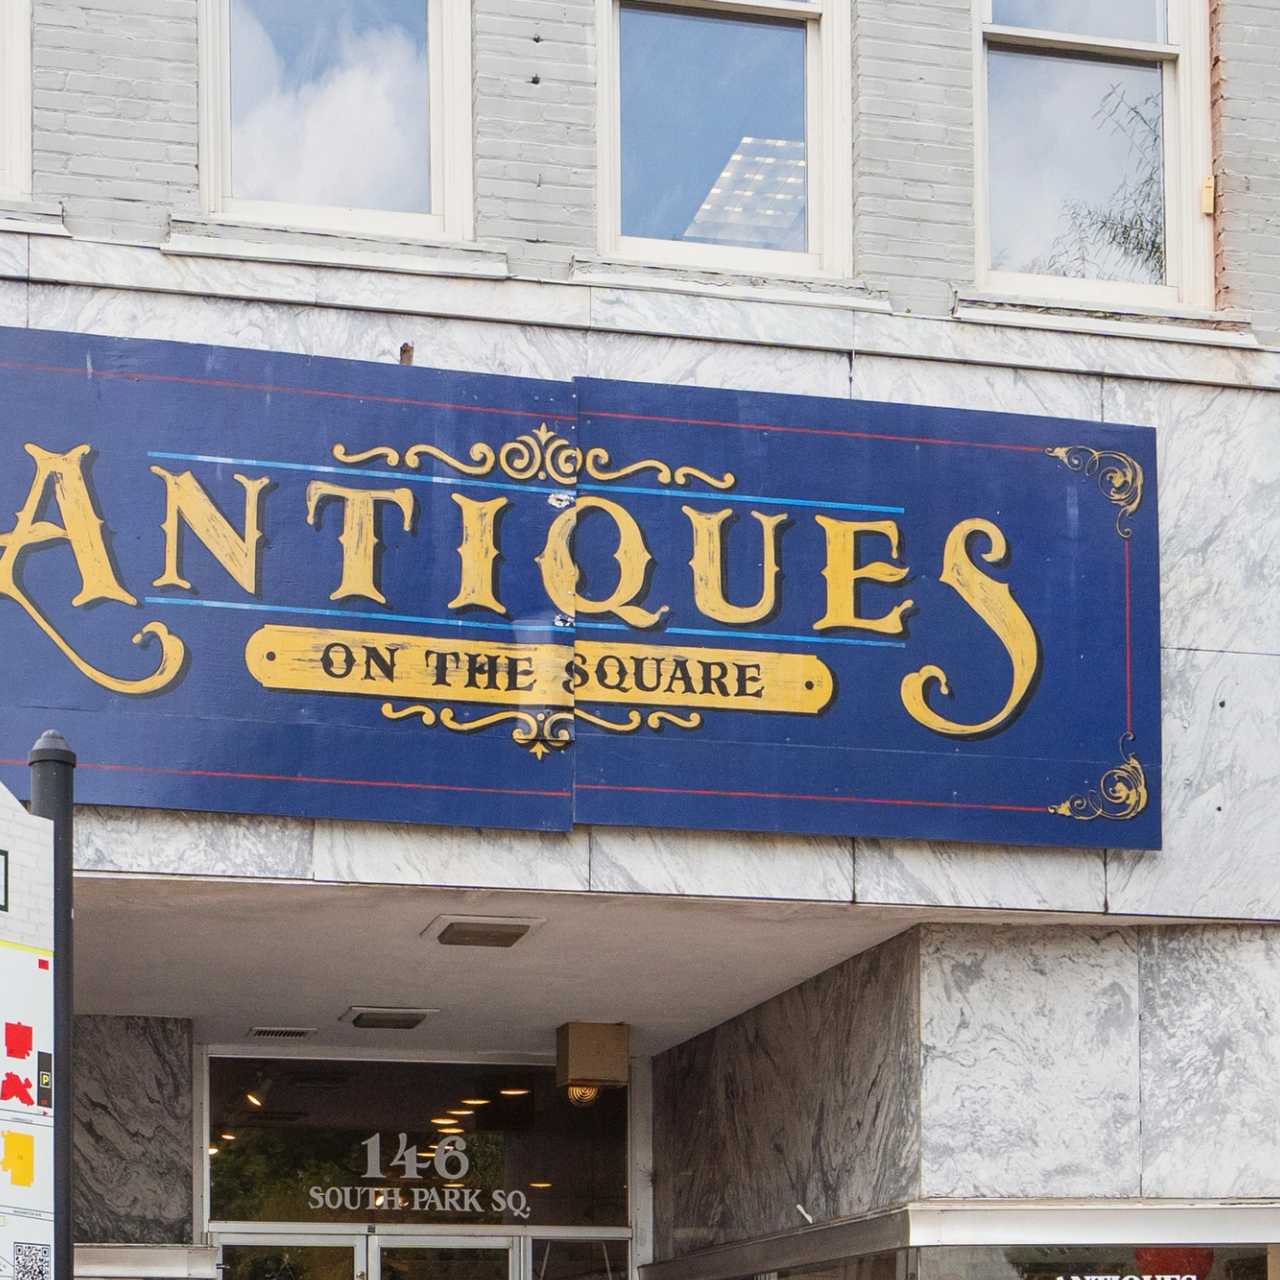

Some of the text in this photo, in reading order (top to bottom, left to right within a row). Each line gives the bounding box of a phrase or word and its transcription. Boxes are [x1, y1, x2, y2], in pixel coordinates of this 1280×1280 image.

[320, 642, 765, 699] ON THE SQUARE
[361, 1132, 470, 1180] 146
[309, 1186, 531, 1218] SOUTH PARK SQ.
